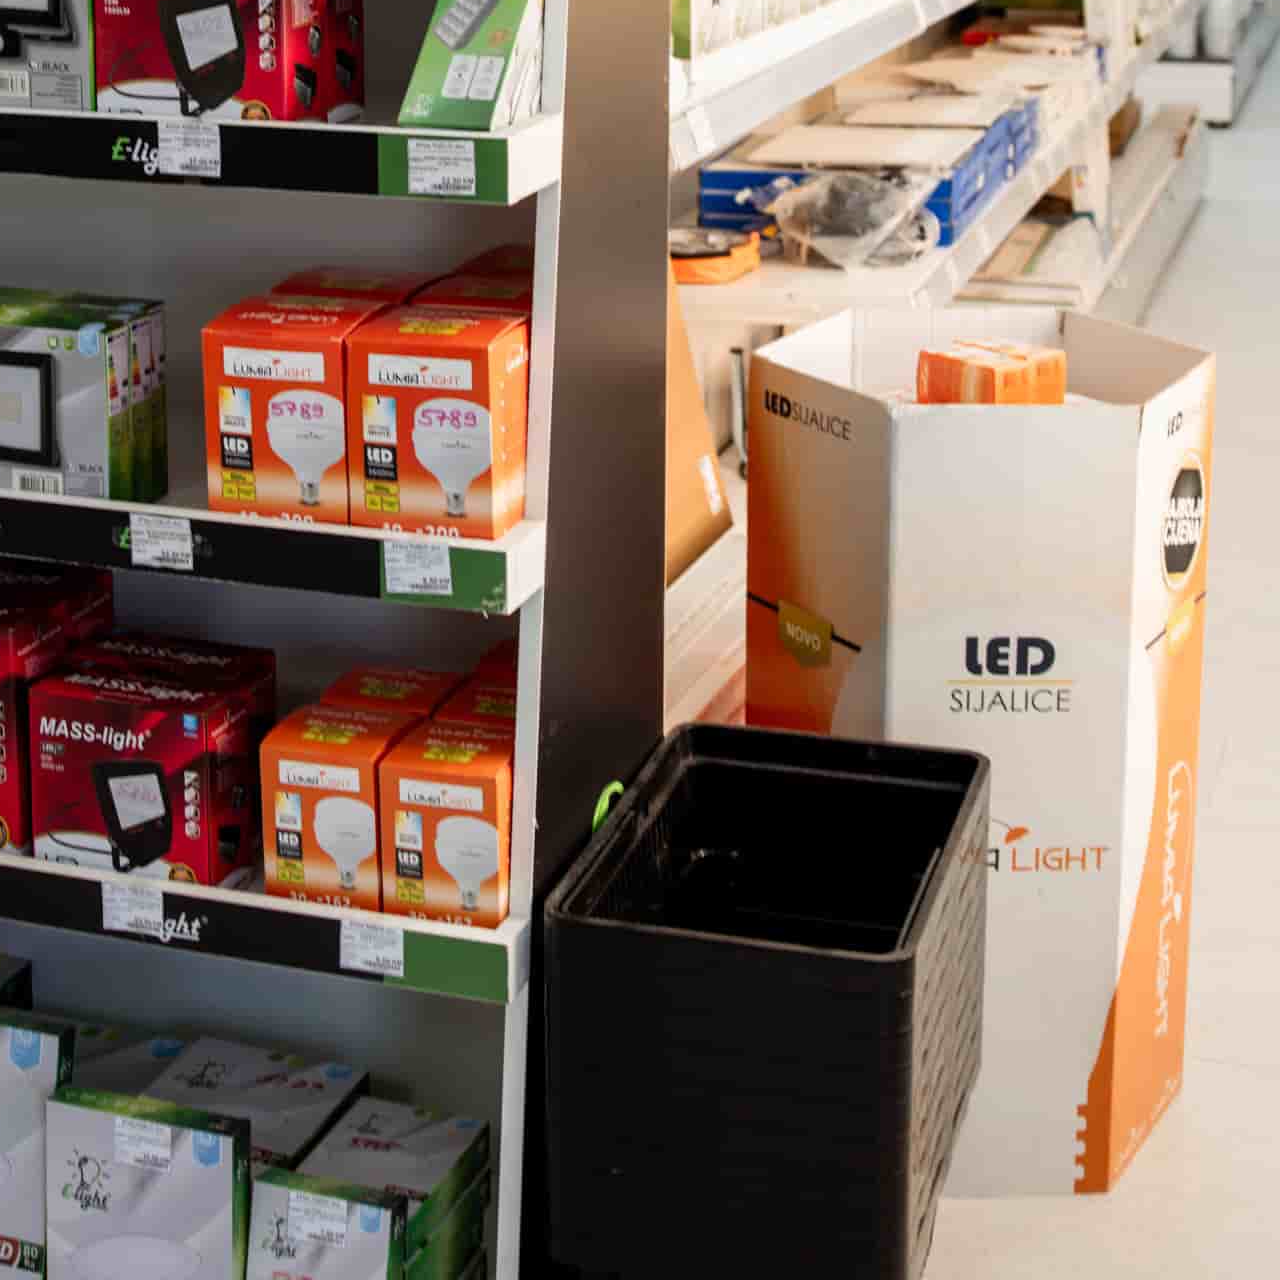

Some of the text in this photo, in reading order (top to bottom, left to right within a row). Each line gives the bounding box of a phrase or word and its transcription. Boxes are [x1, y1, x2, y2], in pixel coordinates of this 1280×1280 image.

[42, 63, 70, 72] BLACK
[270, 400, 324, 420] 5789
[417, 408, 478, 429] 5789
[223, 436, 249, 454] LED
[367, 445, 393, 463] LED
[786, 621, 822, 651] NOVO
[965, 636, 1056, 676] LED
[949, 688, 1071, 714] SIJALICE
[39, 716, 145, 751] MASS-light
[1011, 846, 1111, 872] LIGHT
